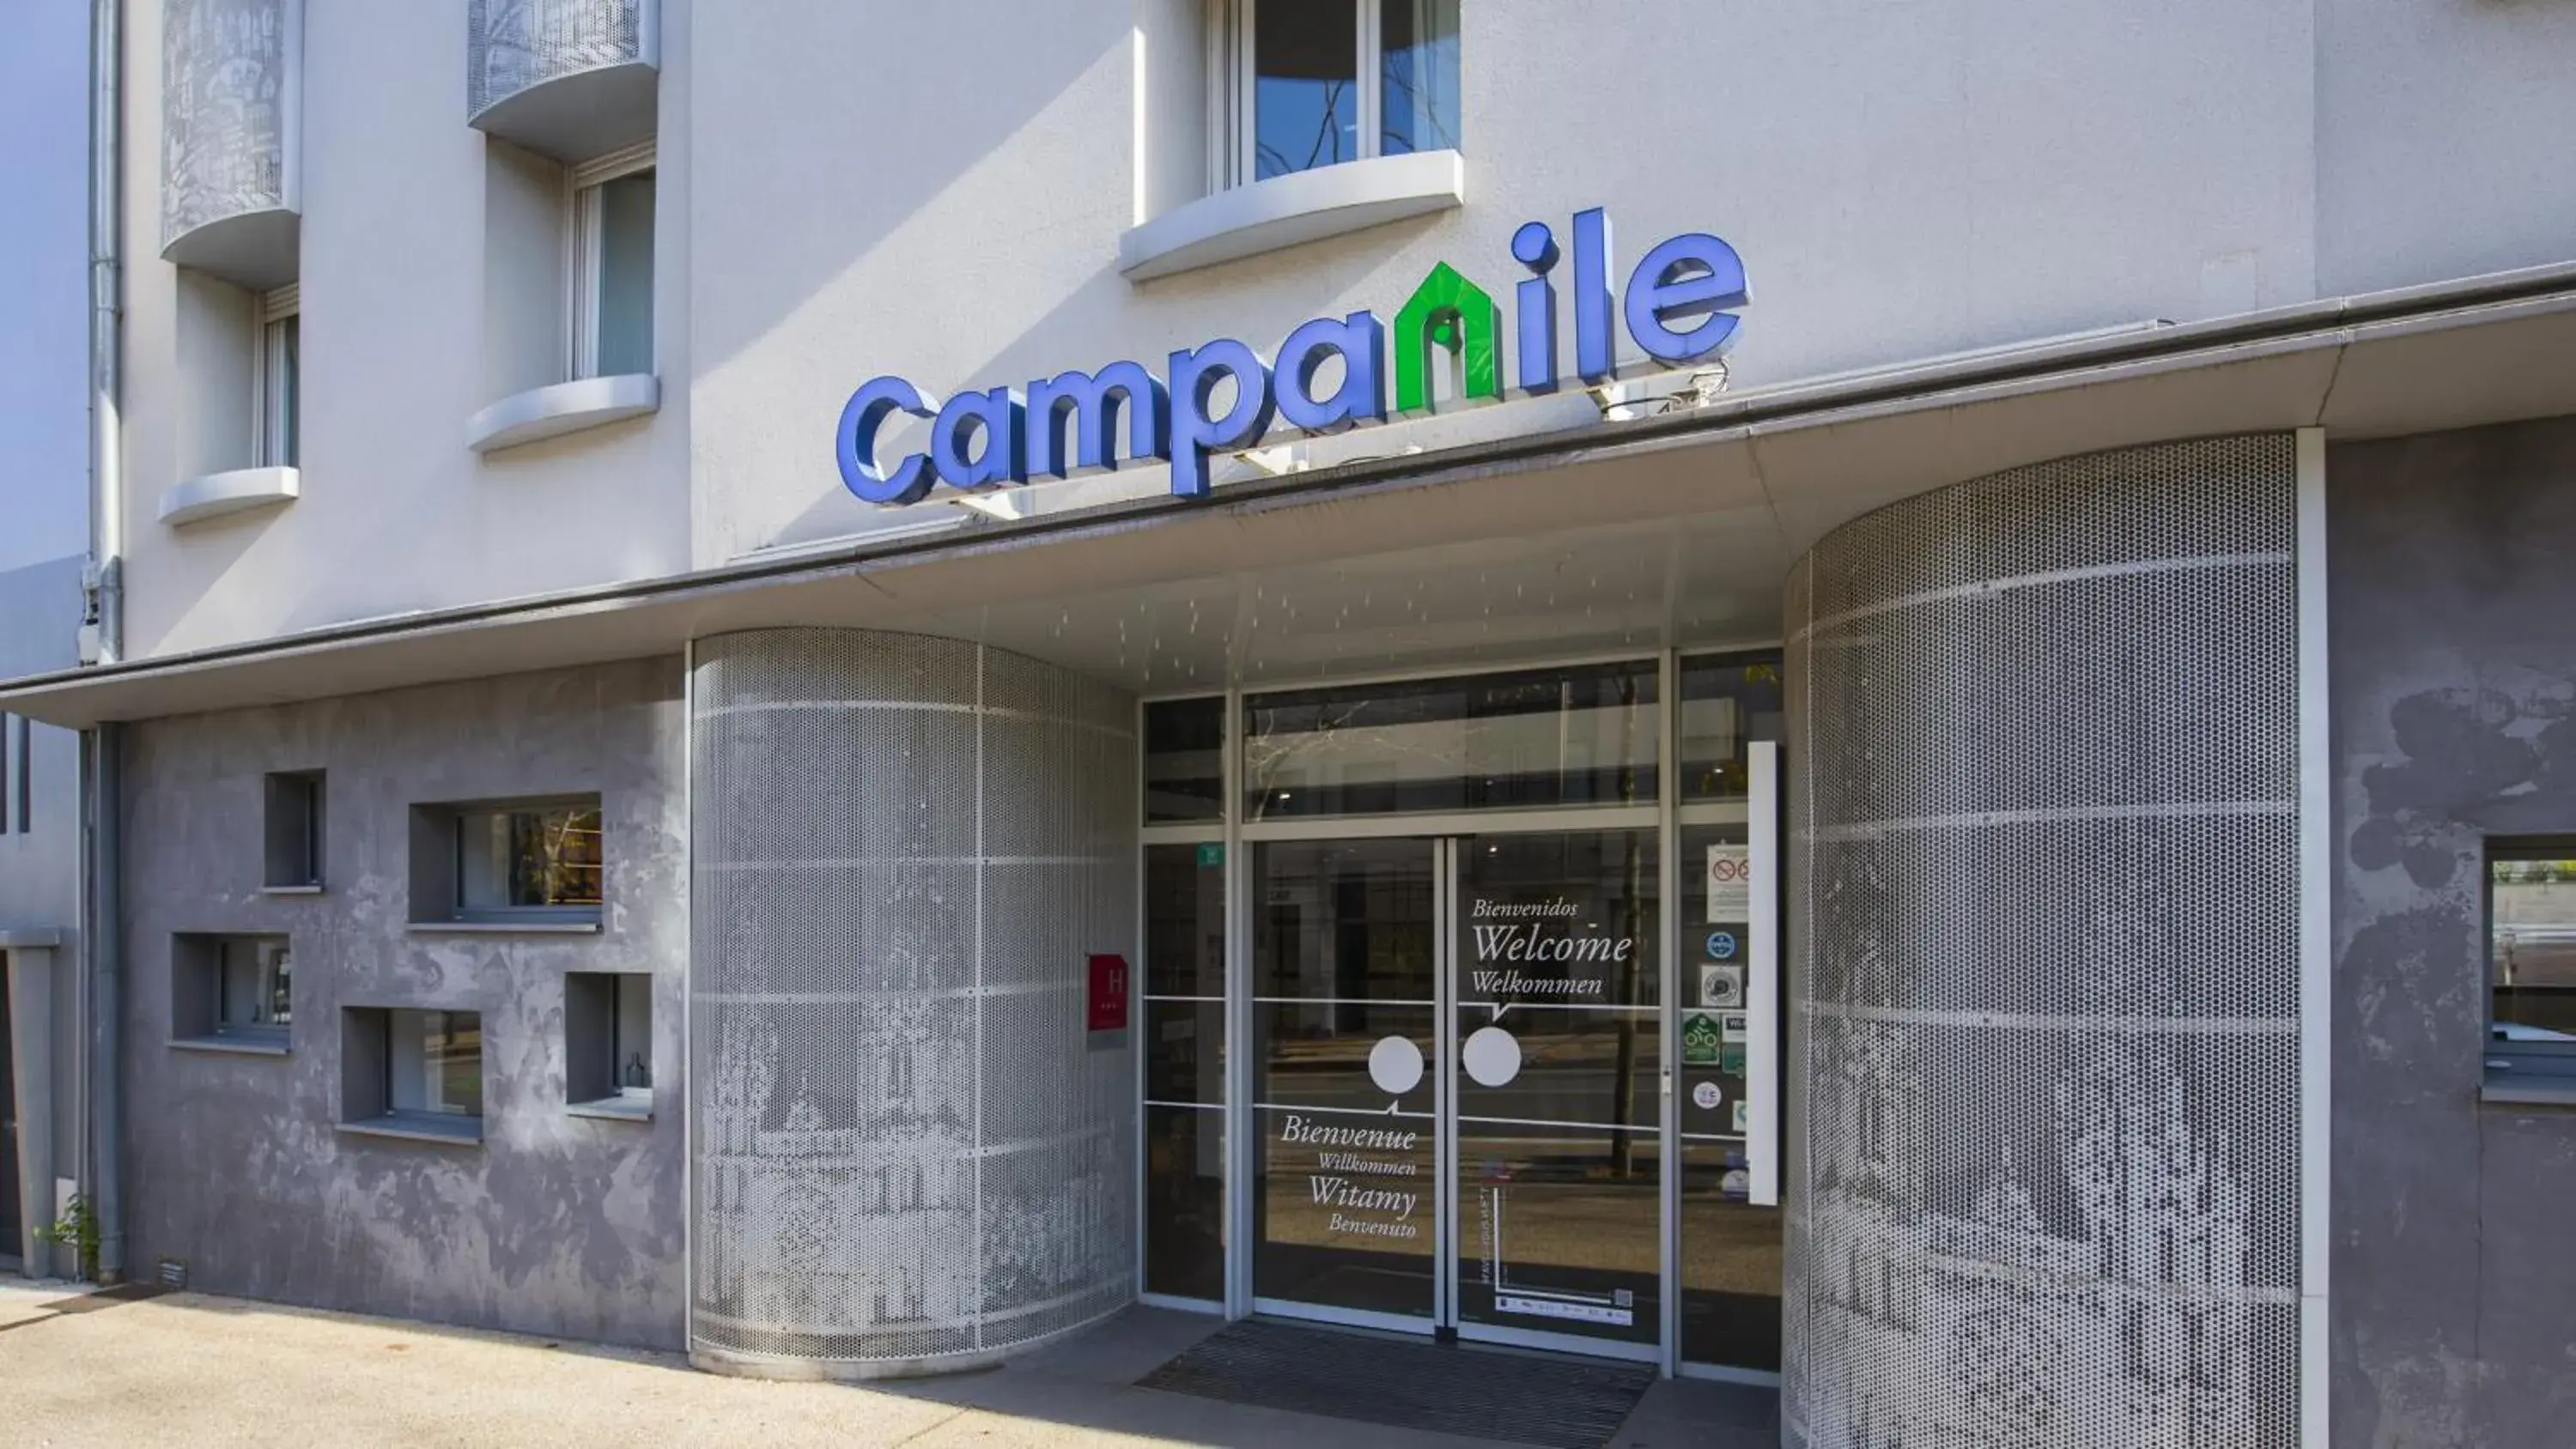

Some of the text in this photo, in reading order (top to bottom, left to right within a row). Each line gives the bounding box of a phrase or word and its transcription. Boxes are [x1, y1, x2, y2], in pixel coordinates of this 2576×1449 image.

[835, 206, 1753, 504] Campanile
[1472, 896, 1578, 917] Bienvenidos
[1473, 923, 1632, 961] Welcome
[1109, 968, 1123, 993] H
[1472, 969, 1604, 994] Welkommen
[1281, 1115, 1416, 1149] Bienvenue
[1319, 1152, 1416, 1175] Willkommen
[1309, 1175, 1416, 1221] Witamy
[1330, 1213, 1416, 1239] Benvenuto
